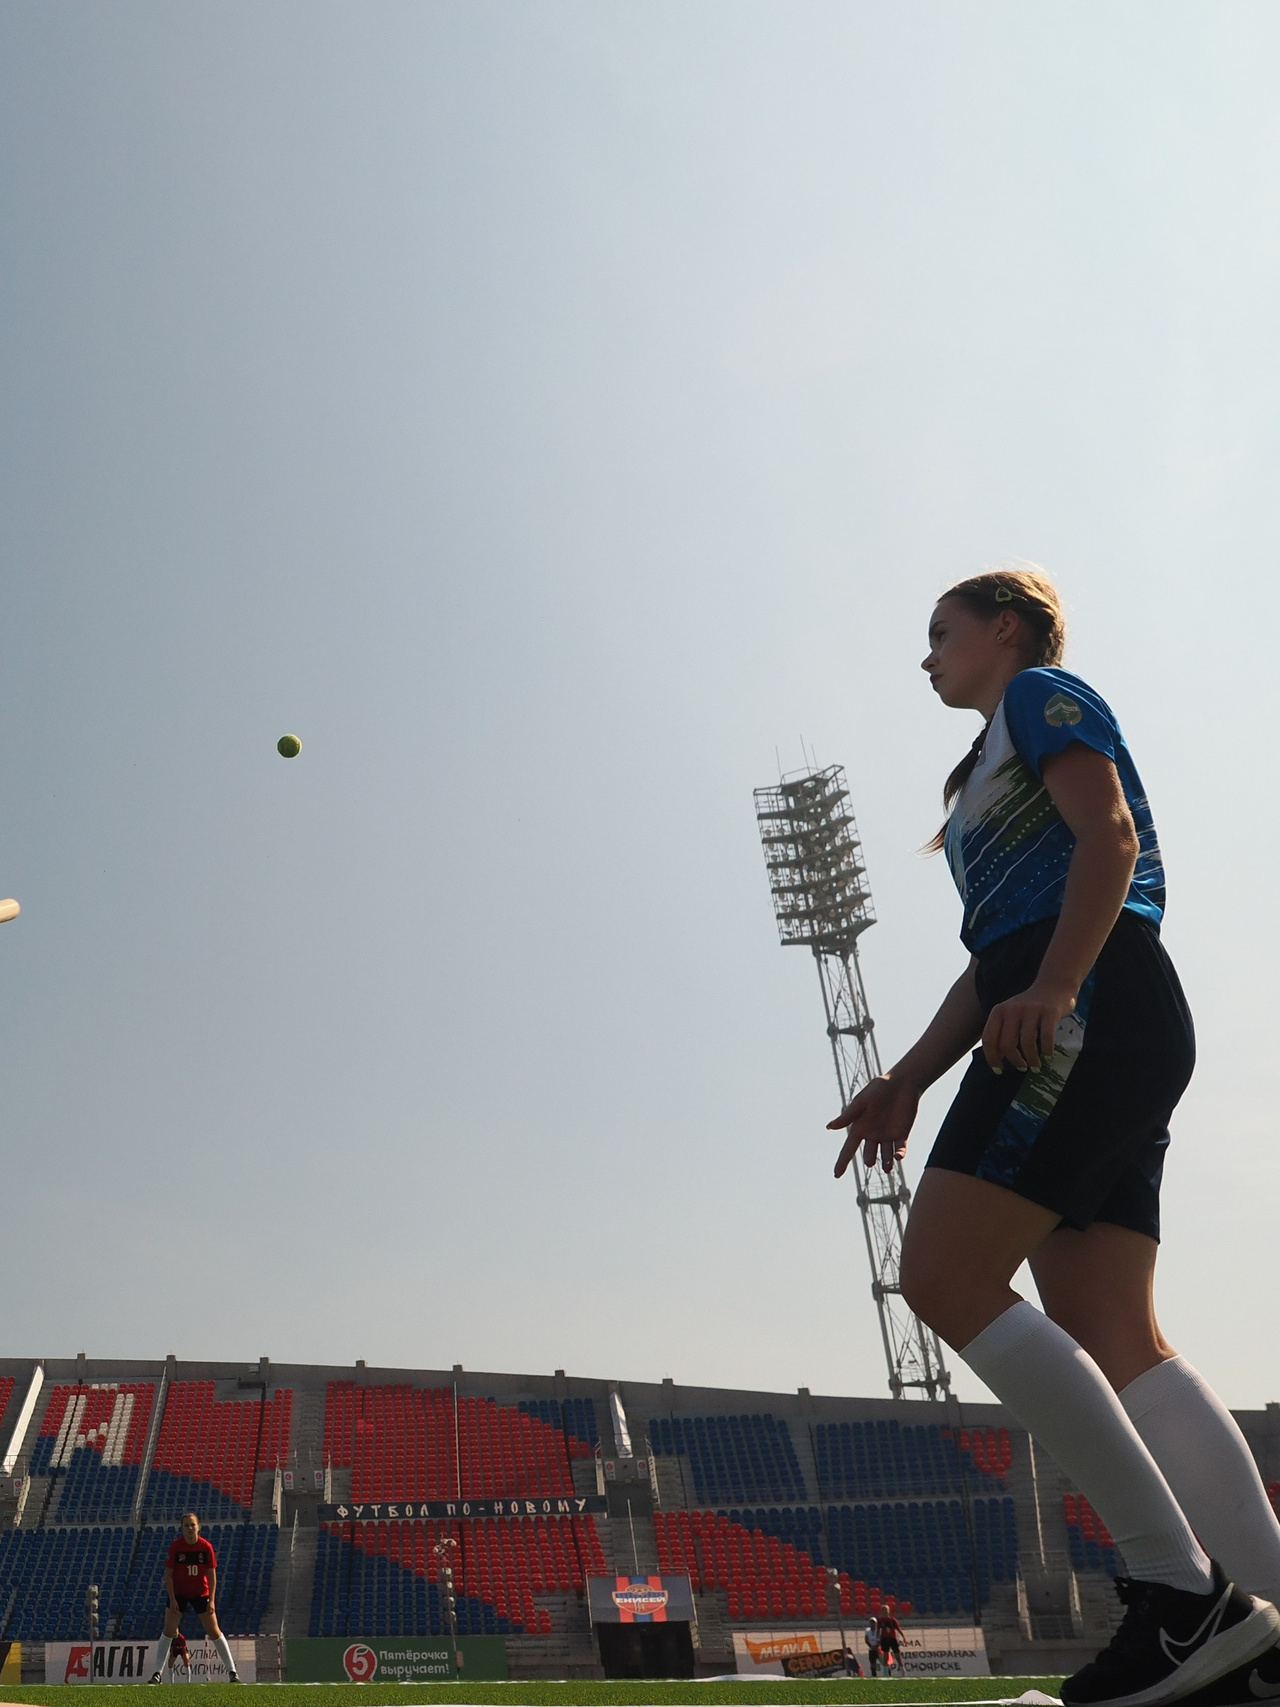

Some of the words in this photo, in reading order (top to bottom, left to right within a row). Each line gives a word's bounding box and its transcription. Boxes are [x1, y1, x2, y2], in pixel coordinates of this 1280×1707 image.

[337, 1504, 429, 1518] ФУТБОЛ
[446, 1498, 587, 1516] ПО-НОВОМУ
[187, 1565, 198, 1576] 10
[93, 1646, 149, 1677] АГАТ
[379, 1650, 448, 1665] Пятёрочка
[788, 1652, 843, 1673] СЕРВИС
[381, 1664, 450, 1678] выручает!
